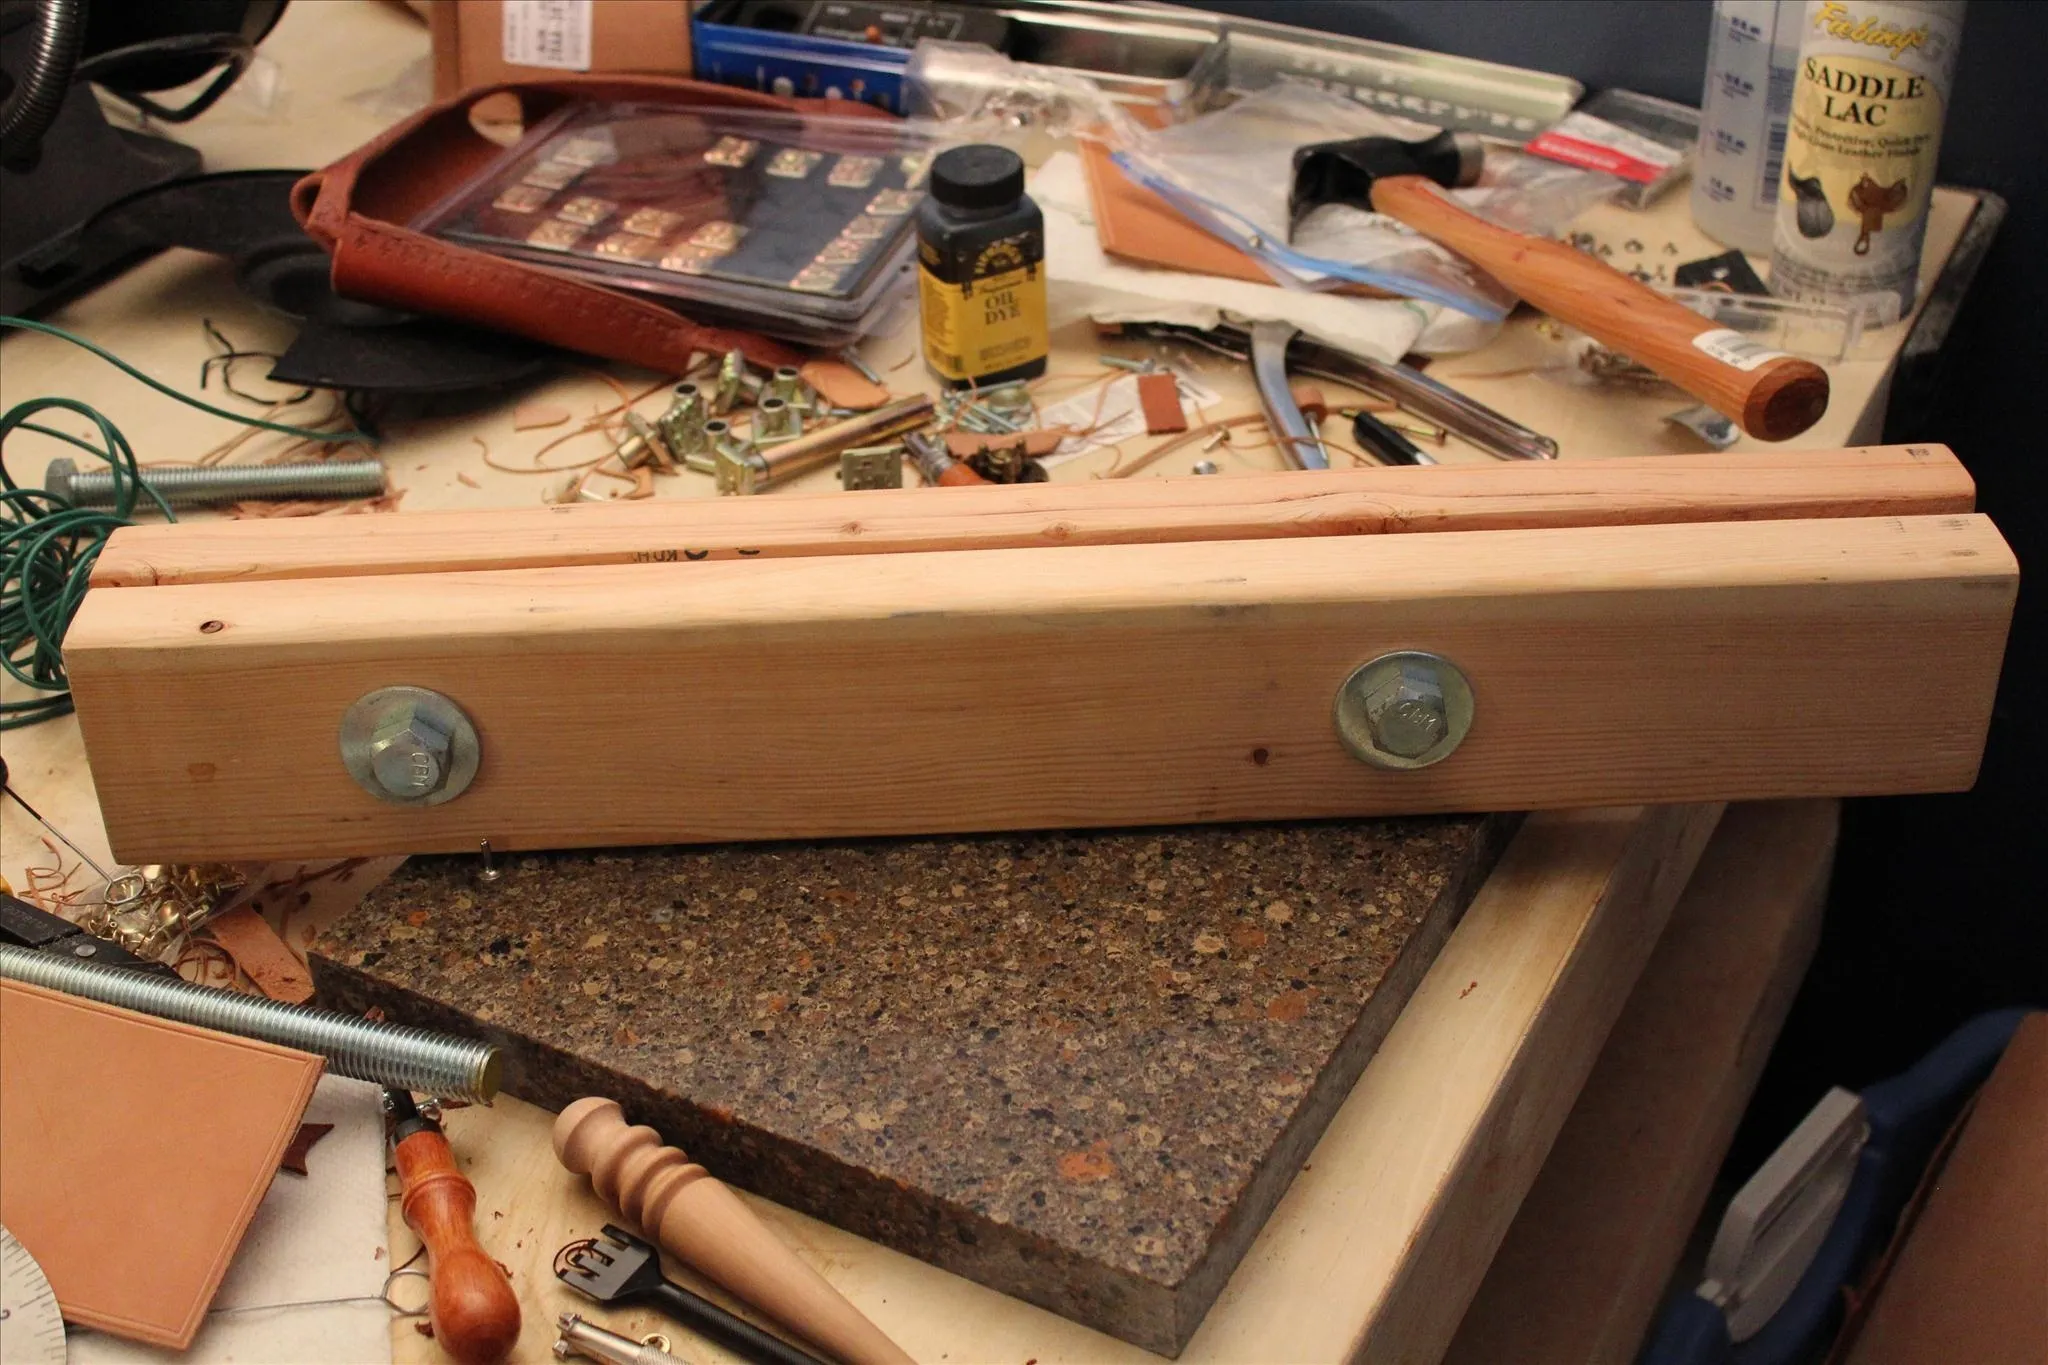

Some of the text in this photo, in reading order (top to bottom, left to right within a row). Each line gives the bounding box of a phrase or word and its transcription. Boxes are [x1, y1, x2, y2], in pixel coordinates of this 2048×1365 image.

[1804, 57, 1924, 100] SADDLE
[1824, 95, 1888, 127] LAC
[984, 291, 1018, 310] OIL
[984, 305, 1022, 325] DYE
